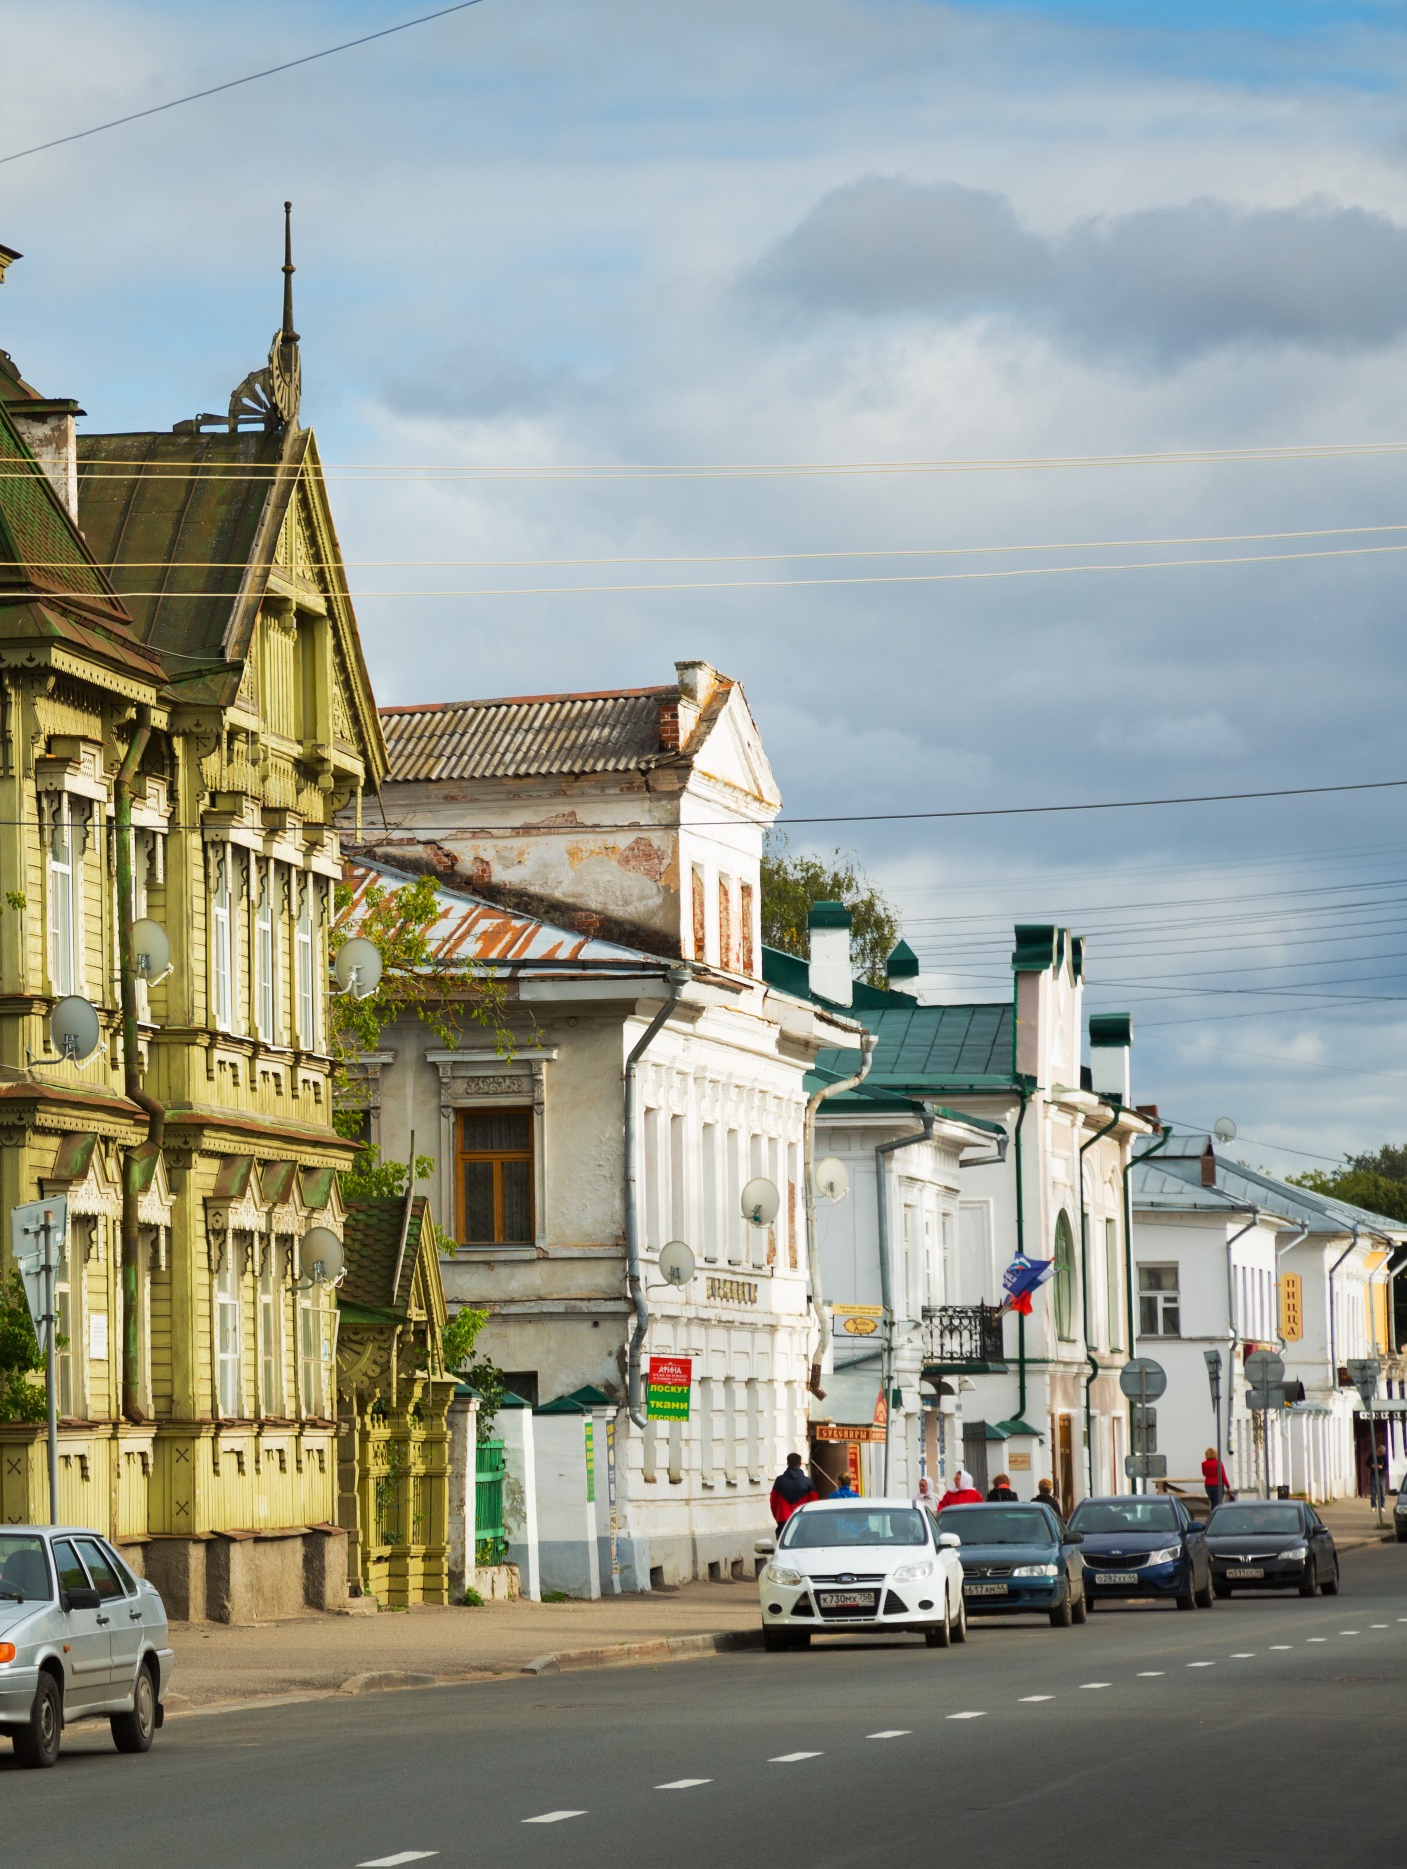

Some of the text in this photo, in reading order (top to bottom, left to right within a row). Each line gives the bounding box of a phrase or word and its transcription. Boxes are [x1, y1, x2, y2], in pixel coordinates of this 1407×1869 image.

[1286, 1279, 1298, 1336] ПИЦЦА
[659, 1366, 682, 1374] АФИНА
[650, 1385, 688, 1394] ЛОСКУТ
[650, 1401, 688, 1410] ткани
[648, 1414, 688, 1423] ВЕСОВЫЕ
[822, 1429, 867, 1440] СУВЕНИРЫ
[858, 1593, 872, 1601] 750
